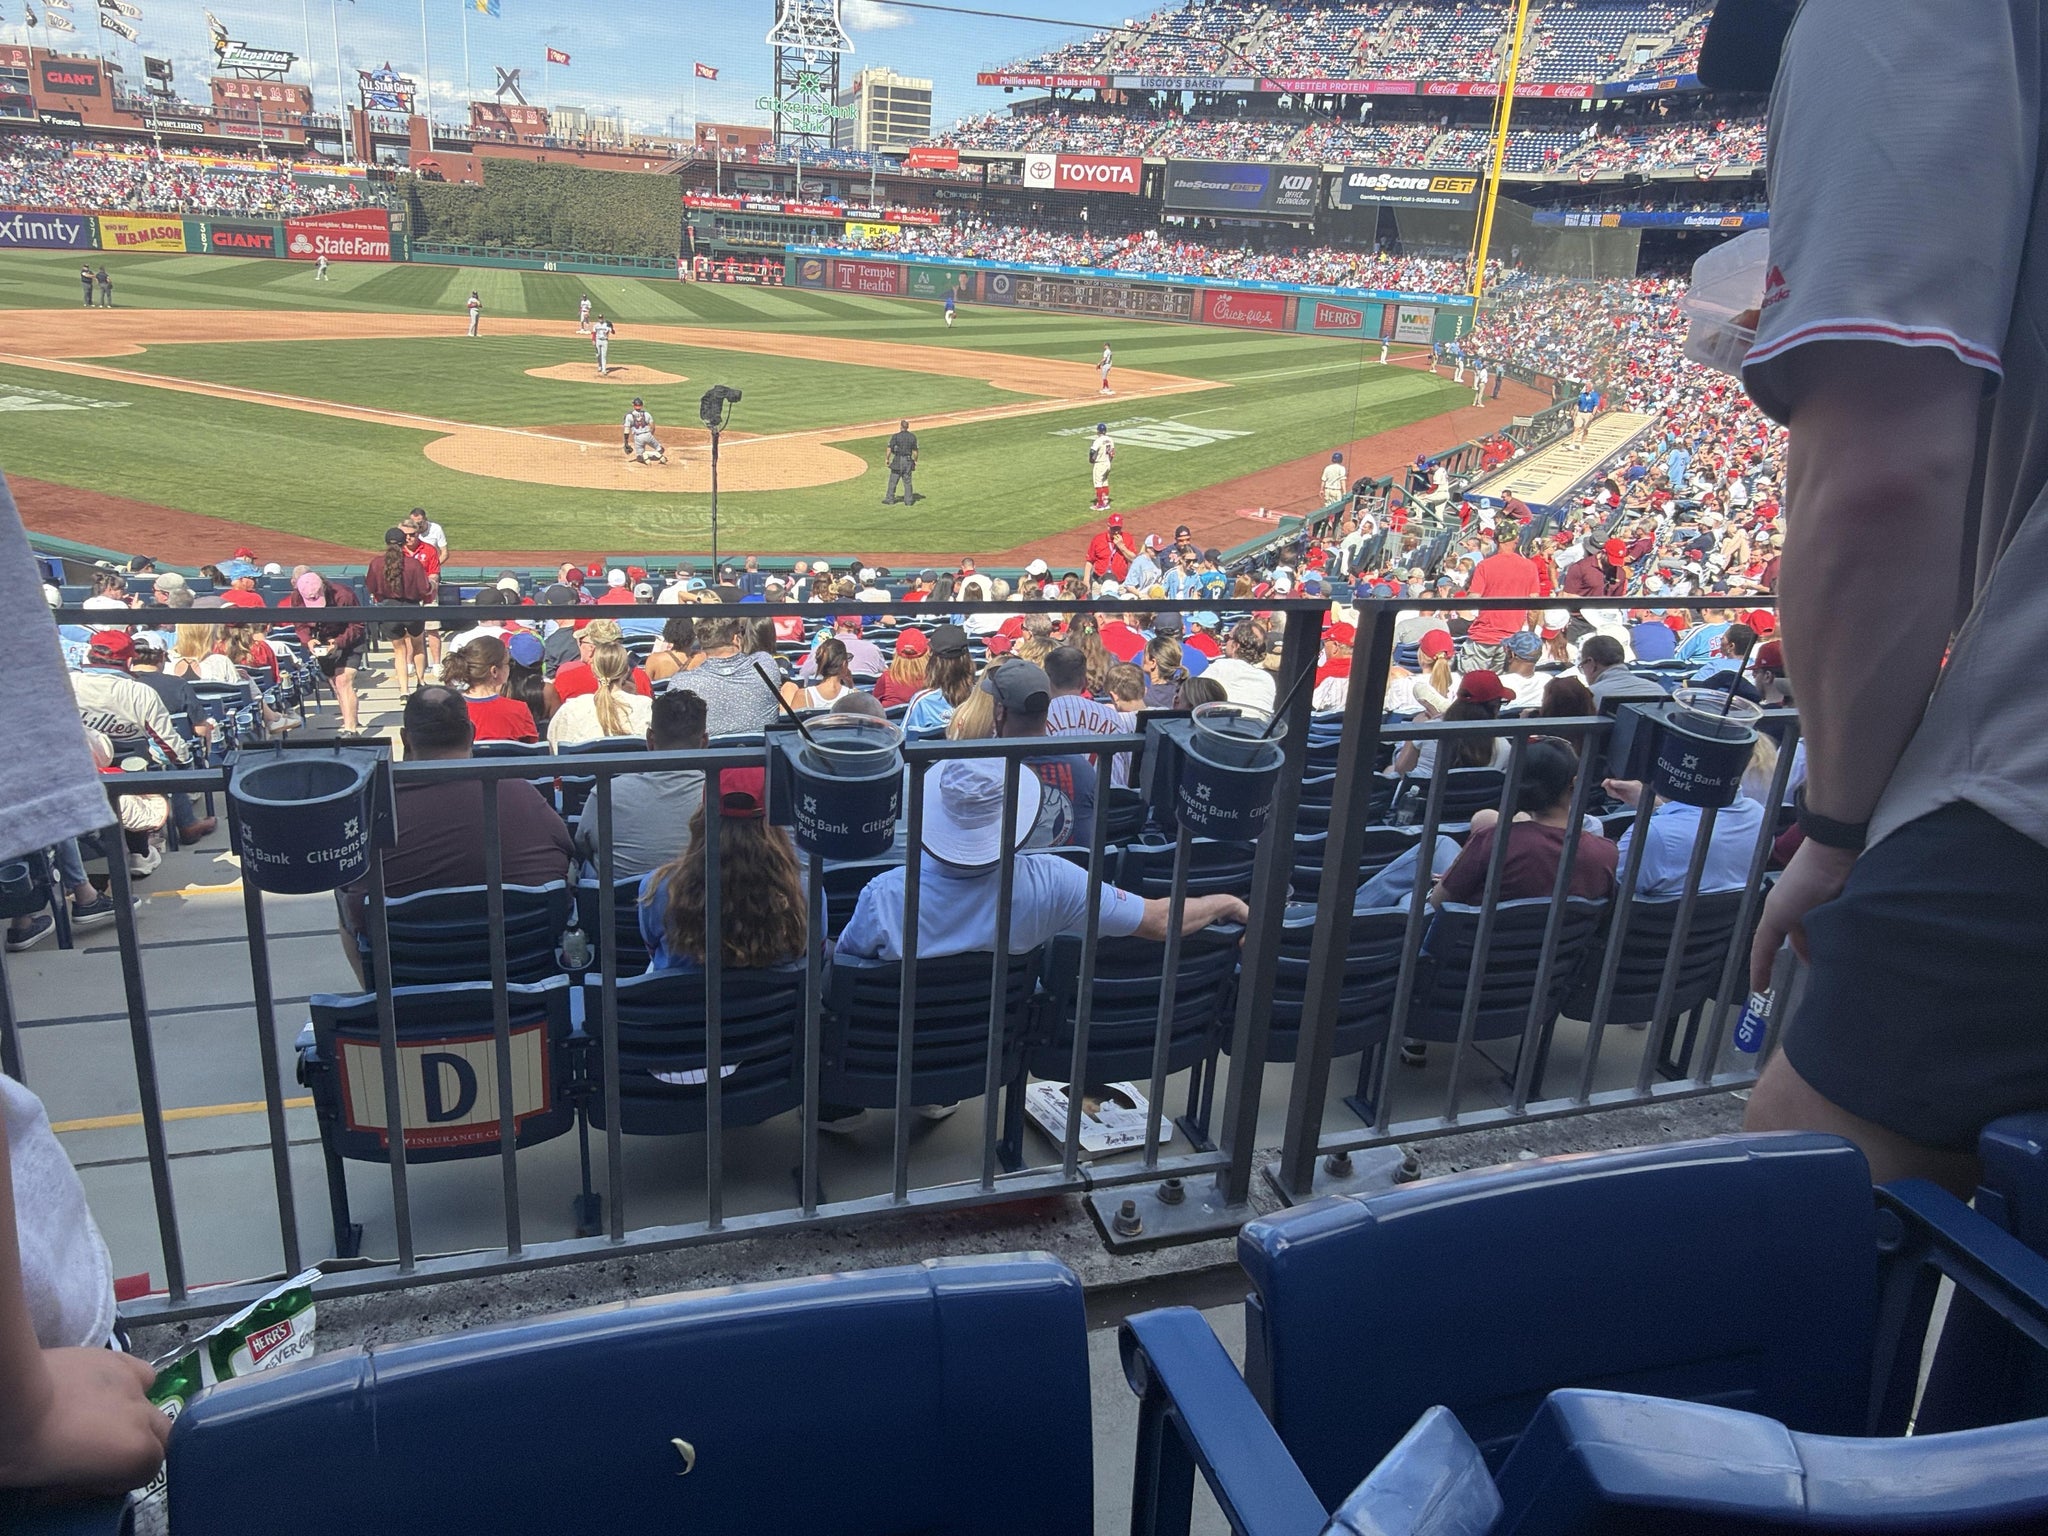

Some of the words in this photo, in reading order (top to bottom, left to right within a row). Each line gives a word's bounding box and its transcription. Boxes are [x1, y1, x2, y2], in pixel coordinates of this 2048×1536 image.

[47, 71, 94, 86] GIANT
[1000, 76, 1025, 85] Phillies
[1027, 77, 1040, 85] win
[1057, 77, 1078, 86] Deals
[1079, 78, 1092, 86] roll
[1093, 78, 1100, 86] in
[1141, 77, 1182, 88] LISCIO'S
[1185, 79, 1225, 89] BAKERY
[375, 80, 393, 92] STAR
[393, 81, 416, 94] GAME
[1295, 82, 1327, 91] BETTER
[1330, 82, 1369, 91] PROTEIN
[1428, 83, 1460, 95] Coca-Cola
[1554, 85, 1588, 97] Coca-Cola
[759, 97, 818, 115] Citizens
[822, 103, 858, 119] Bank
[52, 118, 81, 127] Fanatics
[793, 118, 824, 133] Park
[1060, 164, 1134, 184] TOYOTA
[1349, 172, 1430, 191] theScore
[1434, 180, 1472, 191] BET
[1174, 180, 1230, 190] theScore
[1233, 183, 1260, 192] BET
[1279, 175, 1313, 191] KDI
[700, 200, 732, 208] Budweiser
[802, 205, 834, 216] Budweiser
[902, 214, 933, 223] Budweiser
[1684, 216, 1721, 227] theScore
[1723, 217, 1741, 226] BET
[0, 214, 80, 245] xfinity
[212, 232, 273, 249] GIANT
[315, 235, 353, 255] State
[354, 237, 389, 256] Farm
[544, 262, 557, 271] 401
[858, 265, 895, 279] Temple
[858, 279, 893, 292] Health
[1213, 296, 1272, 324] Chick-fil-A
[1320, 310, 1357, 325] HERR'S
[1402, 314, 1430, 325] WM
[1046, 709, 1117, 736] ALLADAY
[1657, 756, 1692, 780] Citizens
[1694, 773, 1721, 787] Bank
[1668, 775, 1692, 792] Park
[1186, 806, 1208, 825] Park
[1209, 805, 1239, 819] Bank
[817, 819, 849, 835] Bank
[862, 812, 897, 834] Citizen
[798, 821, 818, 841] Park
[256, 848, 290, 865] Bank
[307, 841, 360, 865] Citizens
[339, 851, 363, 872] Park
[420, 1052, 478, 1123] D
[412, 1132, 484, 1145] INSURANCE
[252, 1325, 288, 1354] HERR'S
